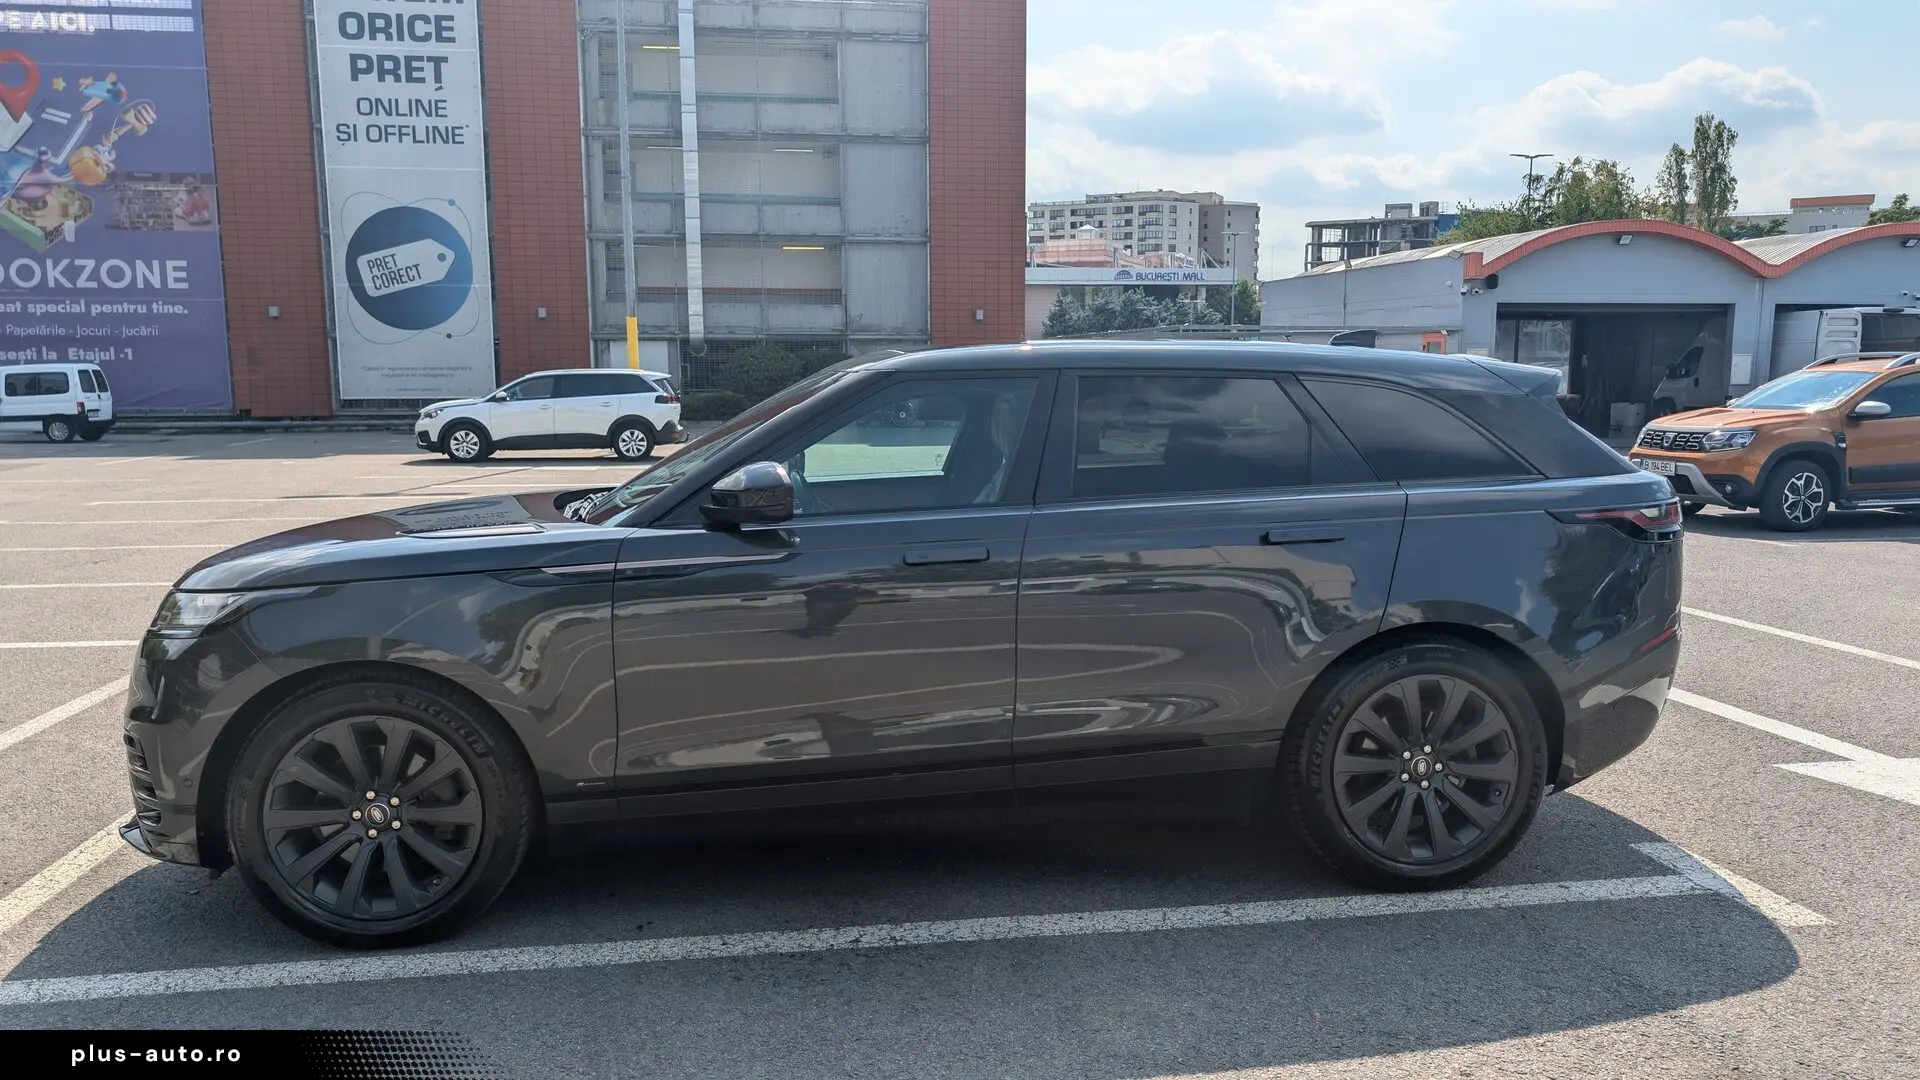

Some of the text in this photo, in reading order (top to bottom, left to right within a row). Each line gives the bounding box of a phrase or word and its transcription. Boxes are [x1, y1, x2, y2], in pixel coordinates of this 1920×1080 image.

[31, 11, 95, 32] AICI.
[338, 12, 456, 43] ORICE
[350, 53, 448, 91] PREȚ
[356, 97, 448, 118] ONLINE
[0, 258, 189, 289] OKZONE
[371, 263, 422, 291] CORECT
[1182, 272, 1205, 281] MALL
[27, 299, 86, 316] special
[90, 301, 147, 316] pentru
[152, 301, 189, 314] tine.
[76, 324, 111, 338] Jocuri
[42, 346, 57, 360] la
[68, 346, 115, 363] Etajul
[119, 347, 133, 360] -1
[1310, 703, 1342, 789] MICHELIN
